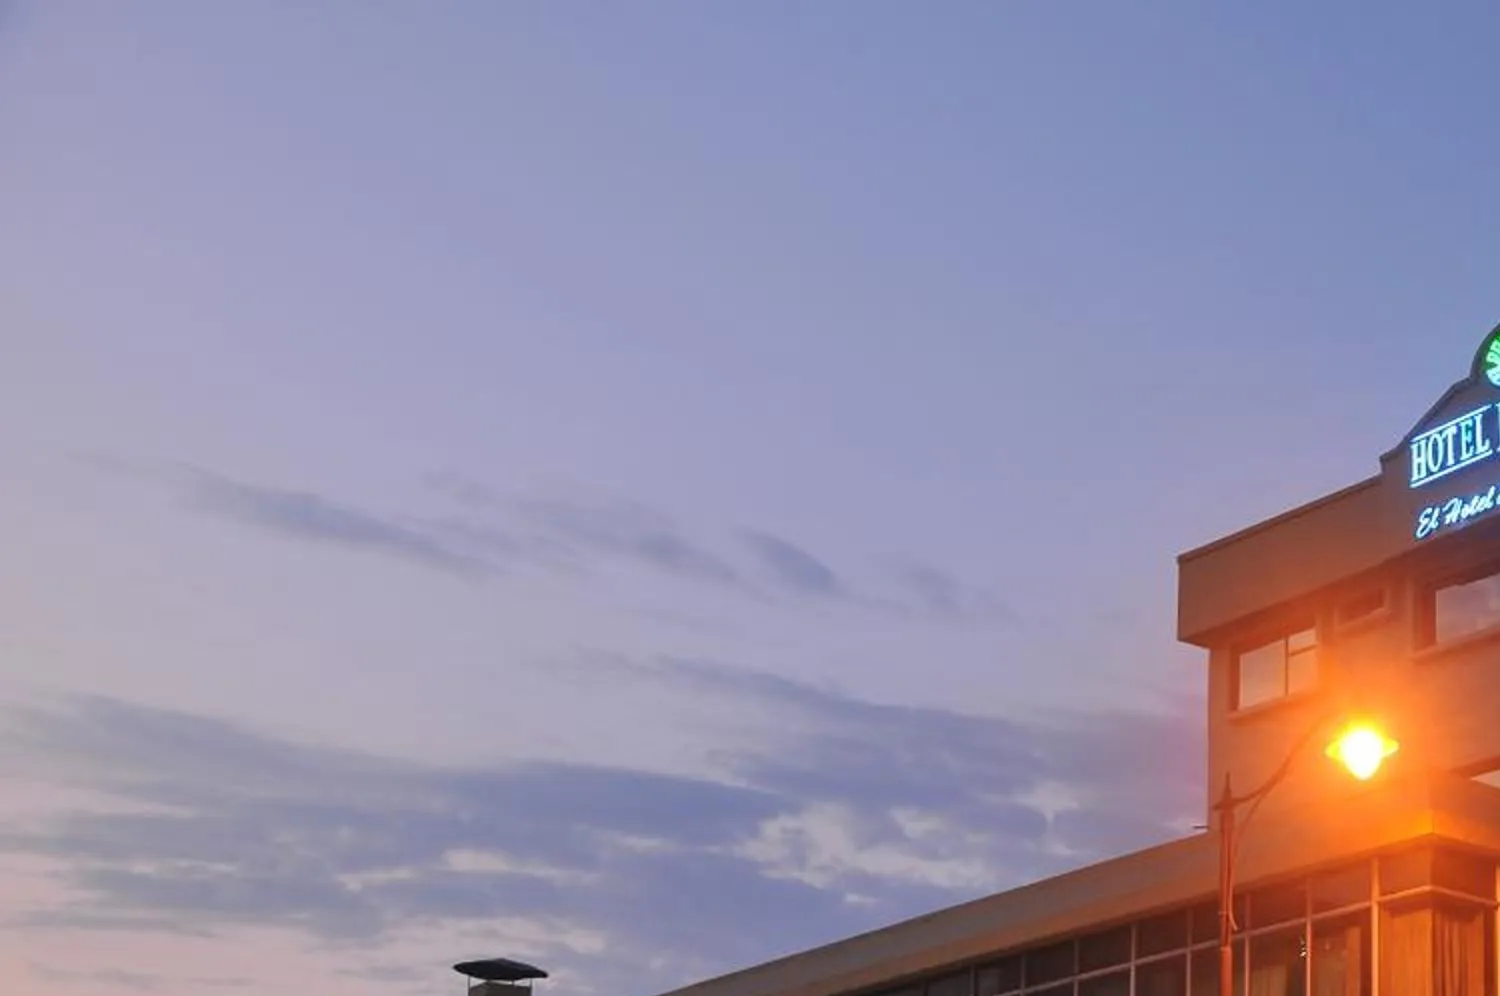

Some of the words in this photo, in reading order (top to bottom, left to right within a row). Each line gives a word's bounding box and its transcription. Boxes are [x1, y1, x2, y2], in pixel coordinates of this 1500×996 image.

[1411, 412, 1491, 482] HOTEL
[1415, 507, 1440, 539] El
[1443, 486, 1495, 525] Hotel
